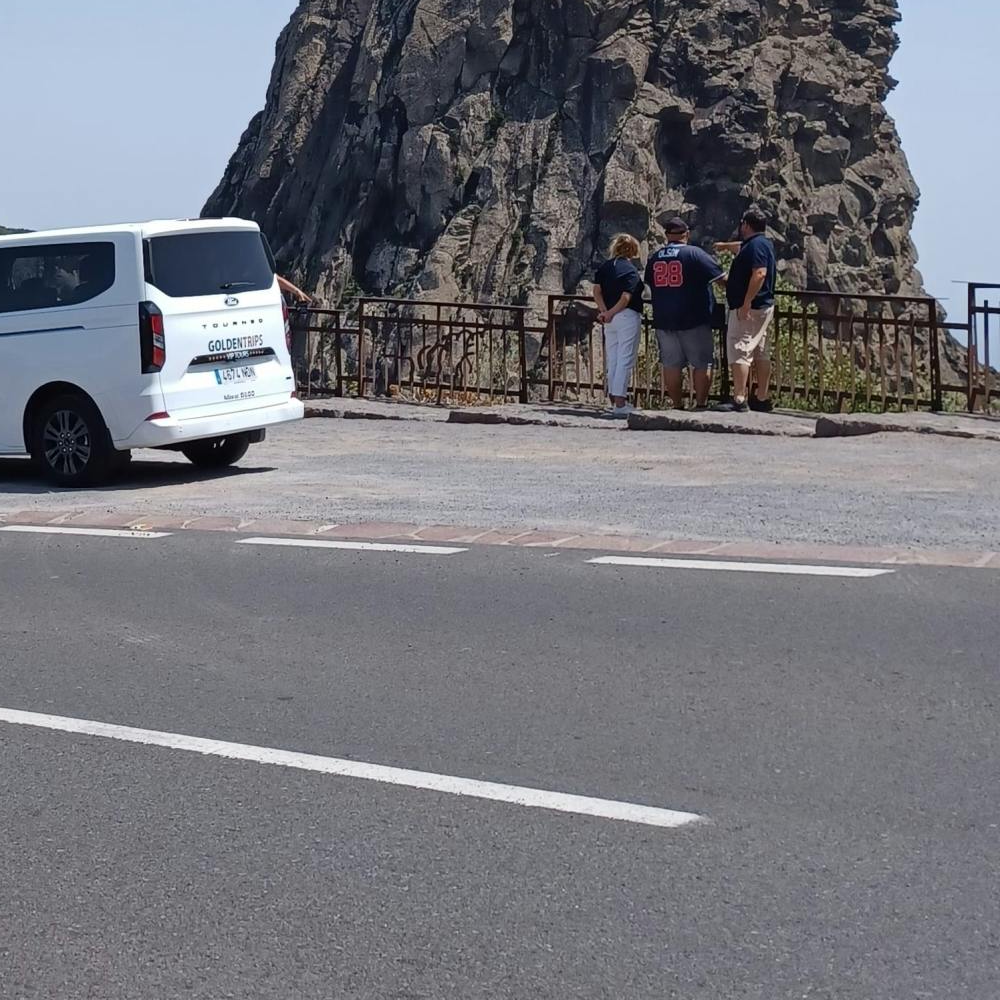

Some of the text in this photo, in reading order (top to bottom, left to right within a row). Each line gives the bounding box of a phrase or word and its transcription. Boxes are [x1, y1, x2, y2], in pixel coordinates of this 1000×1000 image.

[658, 248, 680, 258] OLSON
[653, 260, 684, 287] 28
[202, 318, 264, 329] TOURNEO
[208, 335, 264, 352] GOLDENTRIPS
